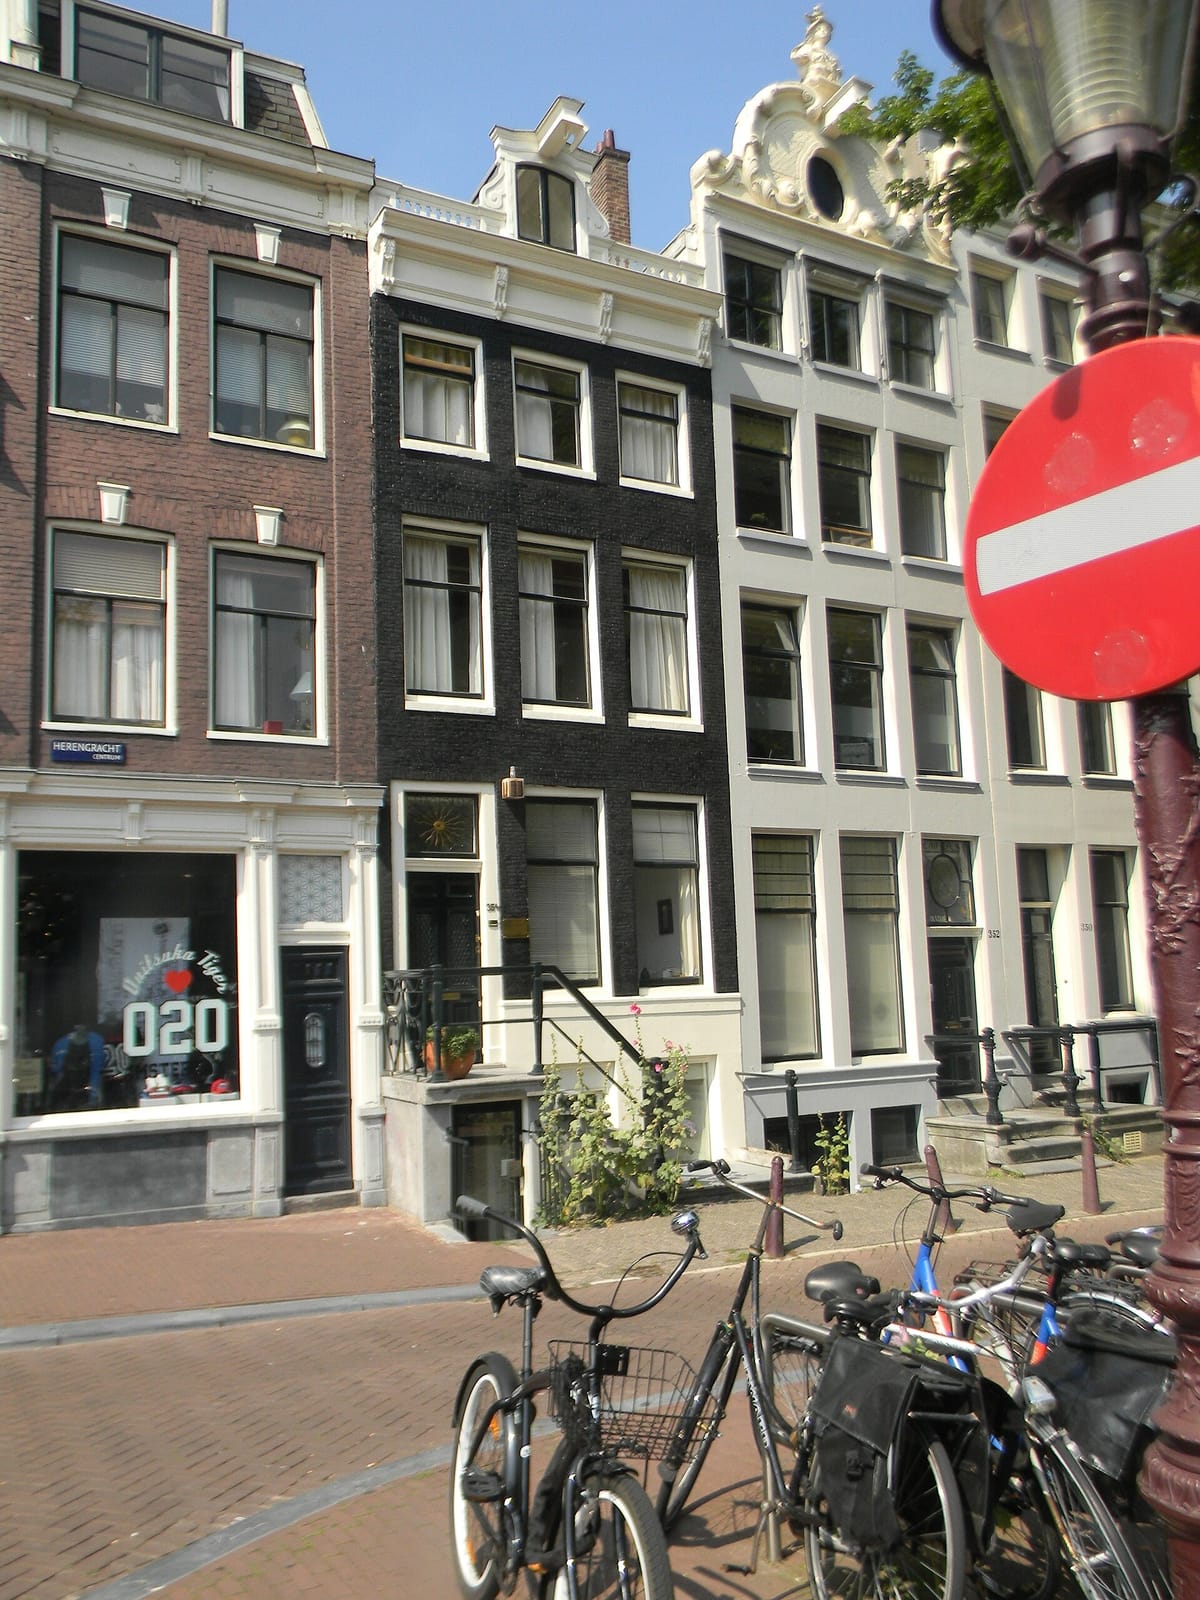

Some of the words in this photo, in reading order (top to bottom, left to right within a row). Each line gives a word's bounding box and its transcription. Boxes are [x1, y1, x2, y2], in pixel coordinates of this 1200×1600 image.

[53, 741, 121, 753] HERENGRACHT
[988, 929, 1000, 938] 352
[122, 943, 196, 996] Onitsuka
[197, 949, 229, 995] Tiger
[123, 999, 228, 1057] 020
